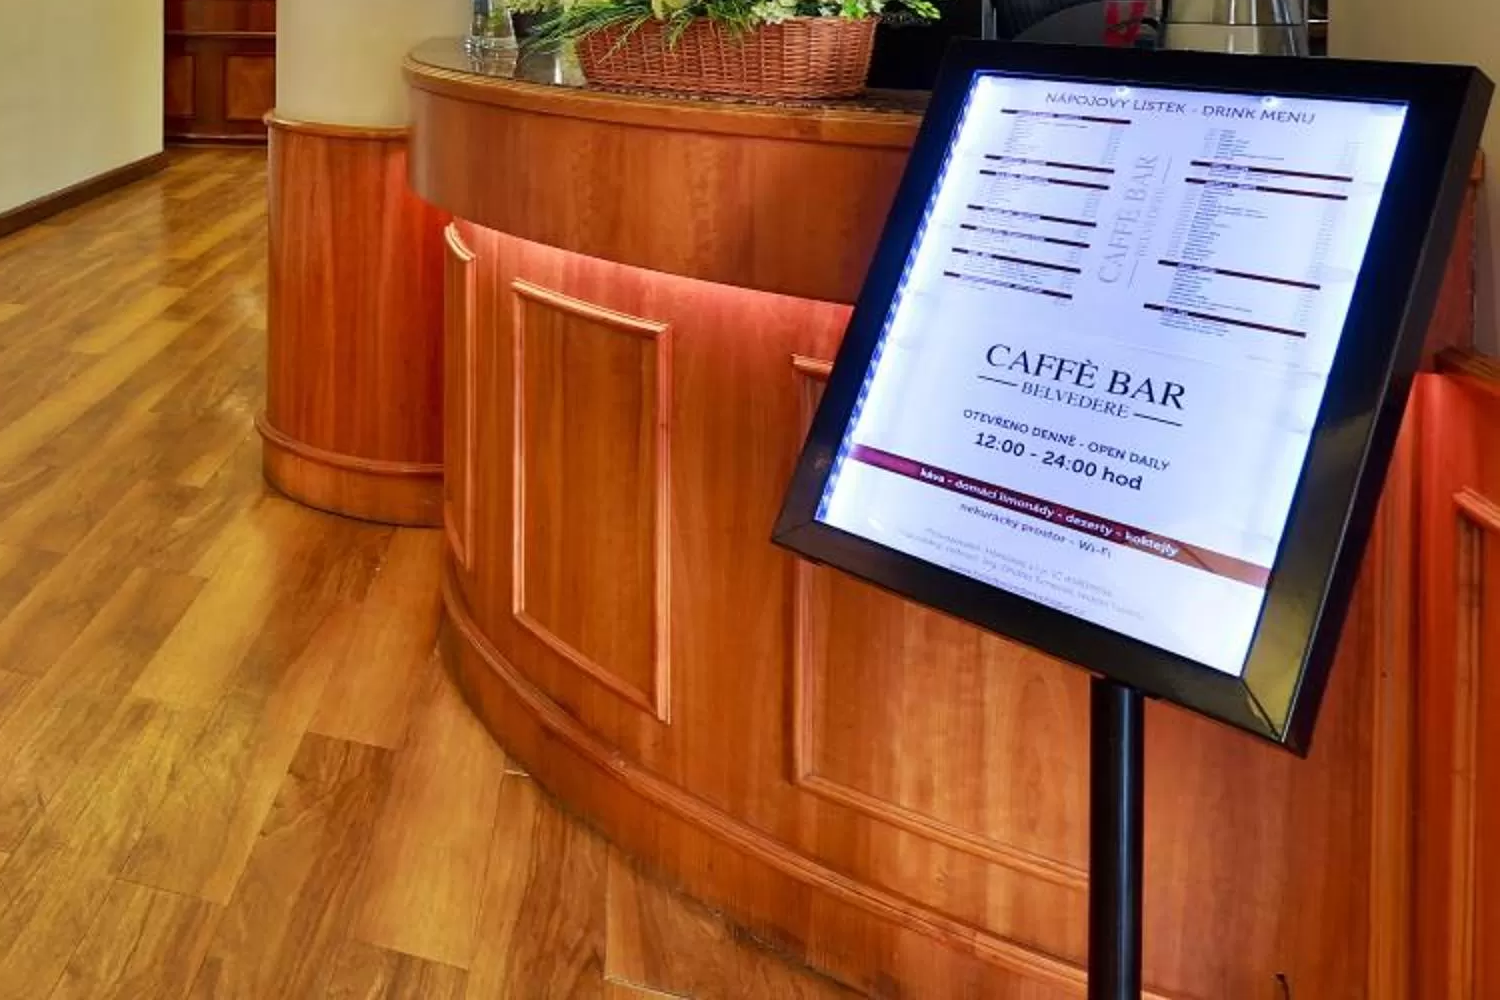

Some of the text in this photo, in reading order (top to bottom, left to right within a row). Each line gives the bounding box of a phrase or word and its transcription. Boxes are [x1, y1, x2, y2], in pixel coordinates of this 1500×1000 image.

[1203, 104, 1256, 120] DRINK
[1260, 109, 1316, 125] MENU
[985, 342, 1186, 410] CAFFÈ BAR
[1020, 380, 1130, 419] BELVEDERE
[974, 431, 1025, 457] 12:00
[1041, 450, 1097, 478] 24:00
[1101, 466, 1144, 491] hod
[1088, 441, 1126, 461] OPEN
[1129, 452, 1171, 472] DAILY
[1065, 512, 1113, 538] dezerty
